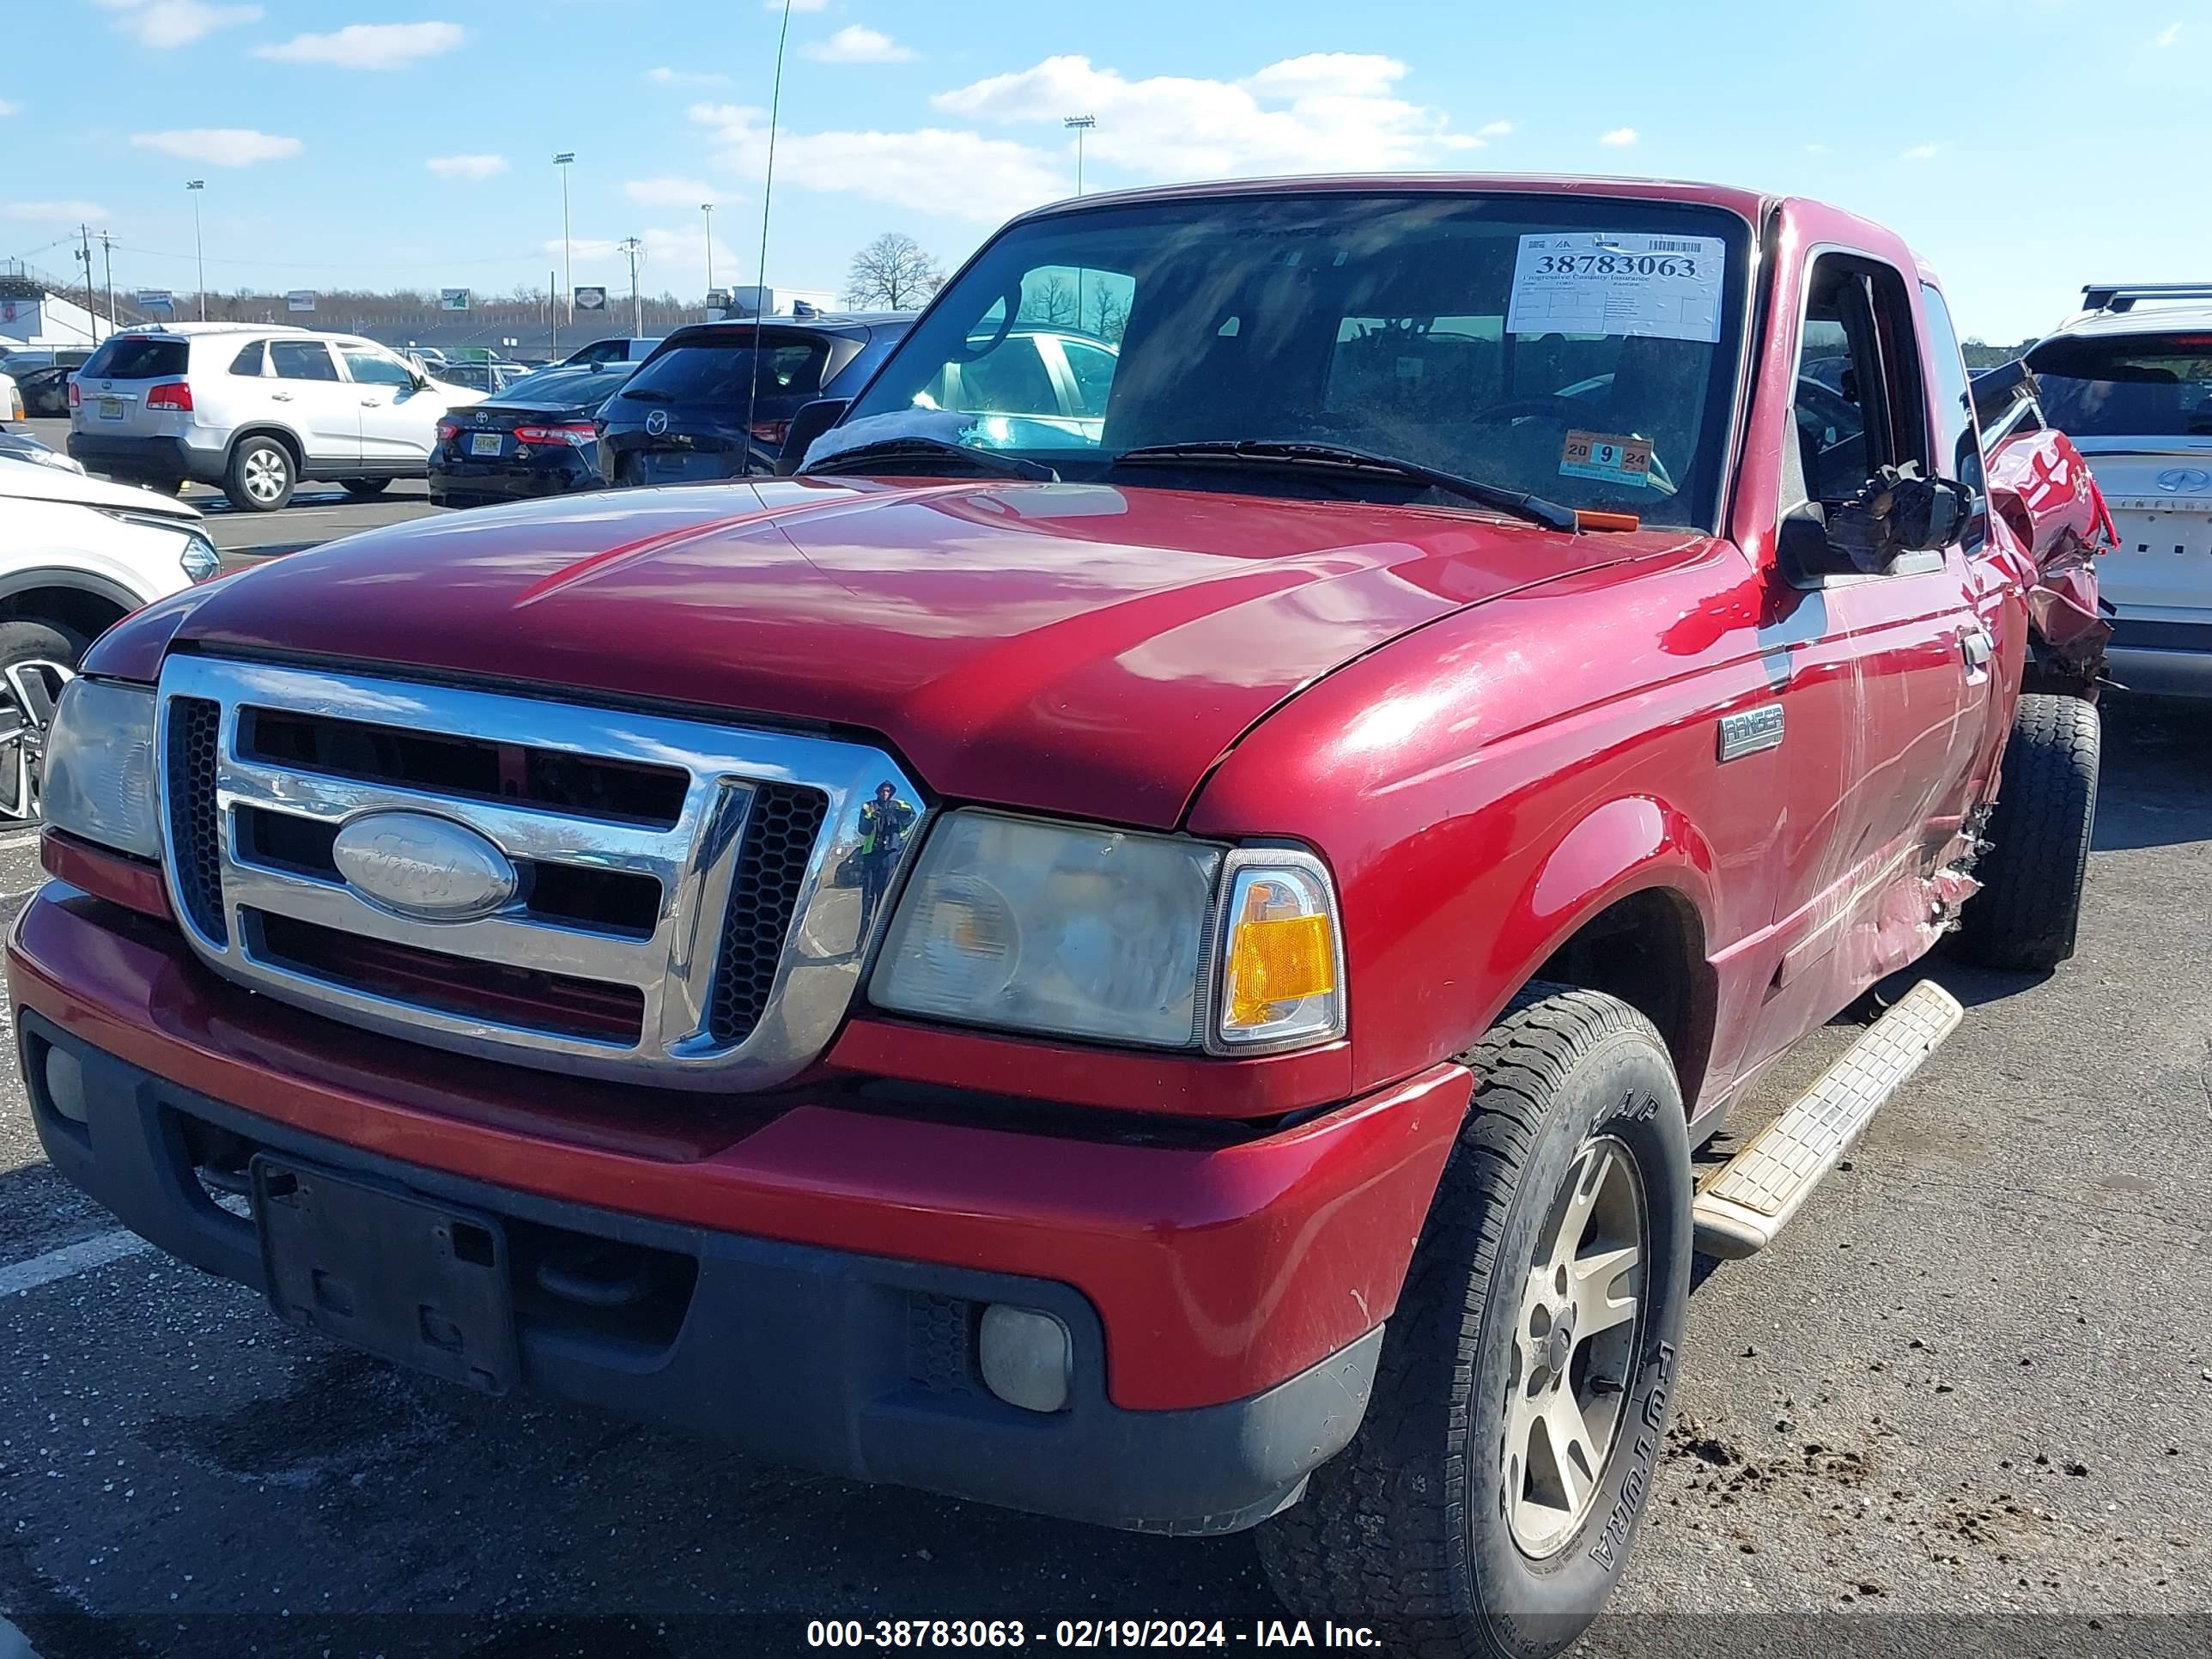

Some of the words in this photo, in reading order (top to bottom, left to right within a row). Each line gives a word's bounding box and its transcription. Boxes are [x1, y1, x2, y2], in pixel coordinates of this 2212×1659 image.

[1535, 255, 1696, 277] 38783063
[1568, 443, 1588, 457] 20
[1600, 446, 1613, 463] 9
[1625, 453, 1646, 465] 24
[1724, 707, 1784, 743] RANGER
[1588, 1339, 1675, 1572] FUTURA
